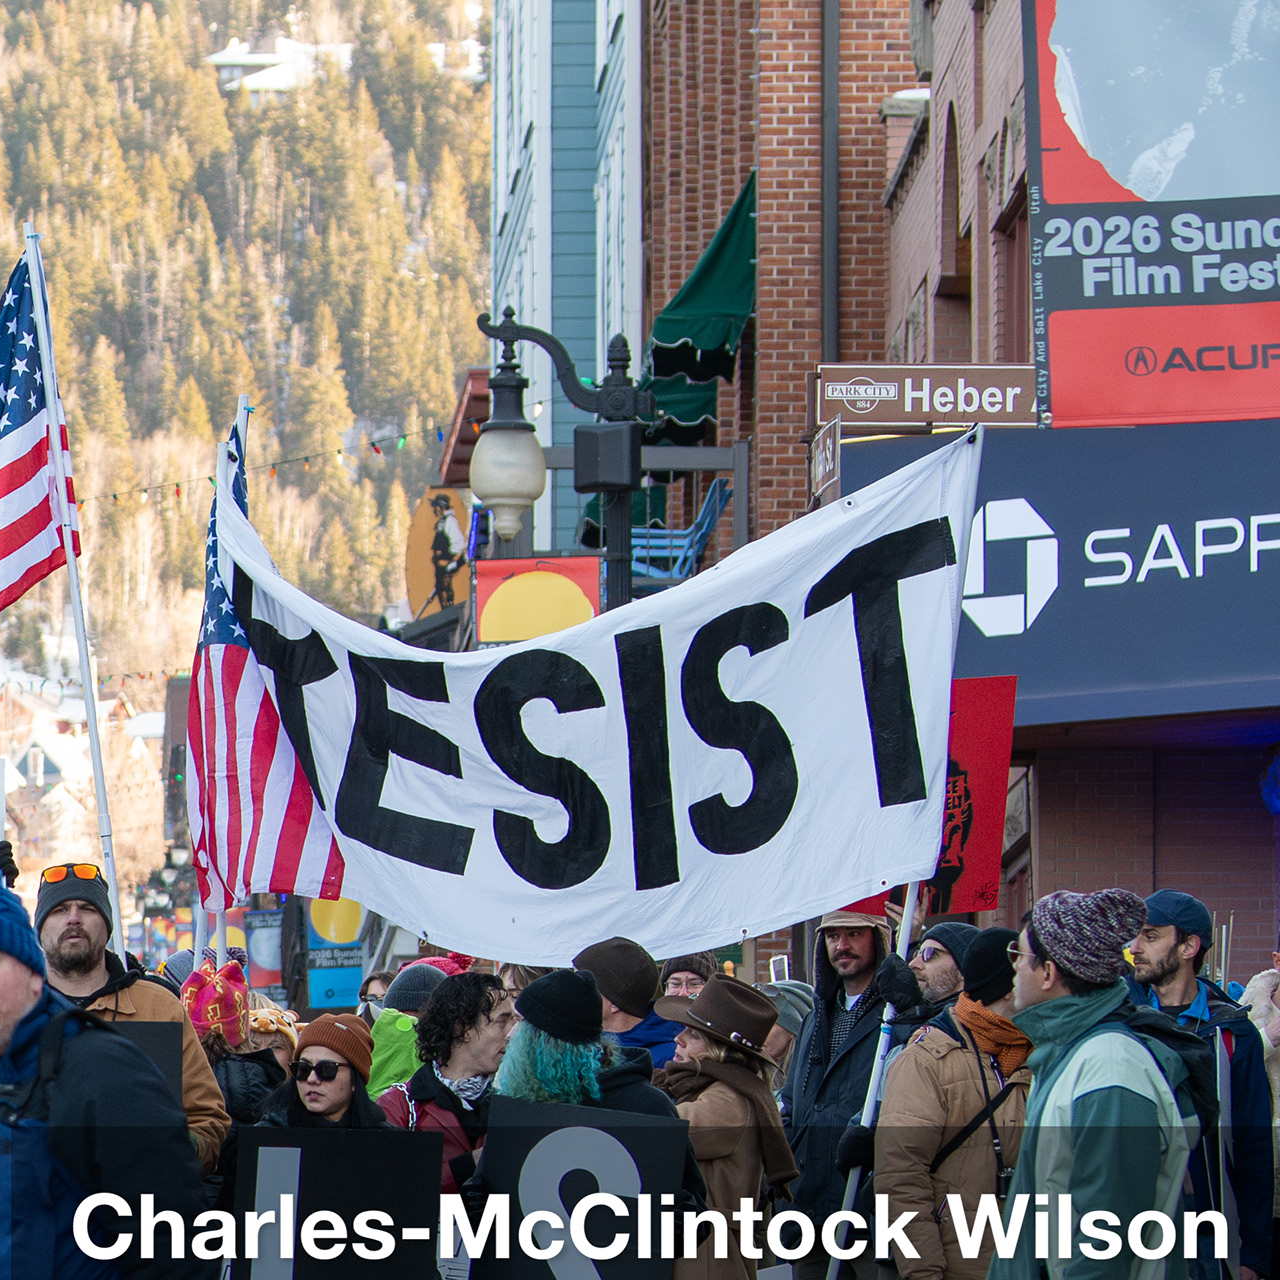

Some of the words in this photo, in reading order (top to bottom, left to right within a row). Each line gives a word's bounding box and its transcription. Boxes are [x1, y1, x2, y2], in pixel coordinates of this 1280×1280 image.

[1030, 185, 1040, 214] Utah
[1044, 215, 1161, 257] 2026
[1032, 238, 1042, 266] City
[1033, 272, 1043, 300] Lake
[1083, 256, 1181, 297] Film
[1035, 307, 1045, 335] Salt
[1036, 341, 1046, 362] And
[831, 387, 861, 397] PARK
[864, 386, 892, 396] CITY
[904, 378, 1021, 413] Heber
[1037, 369, 1048, 397] City
